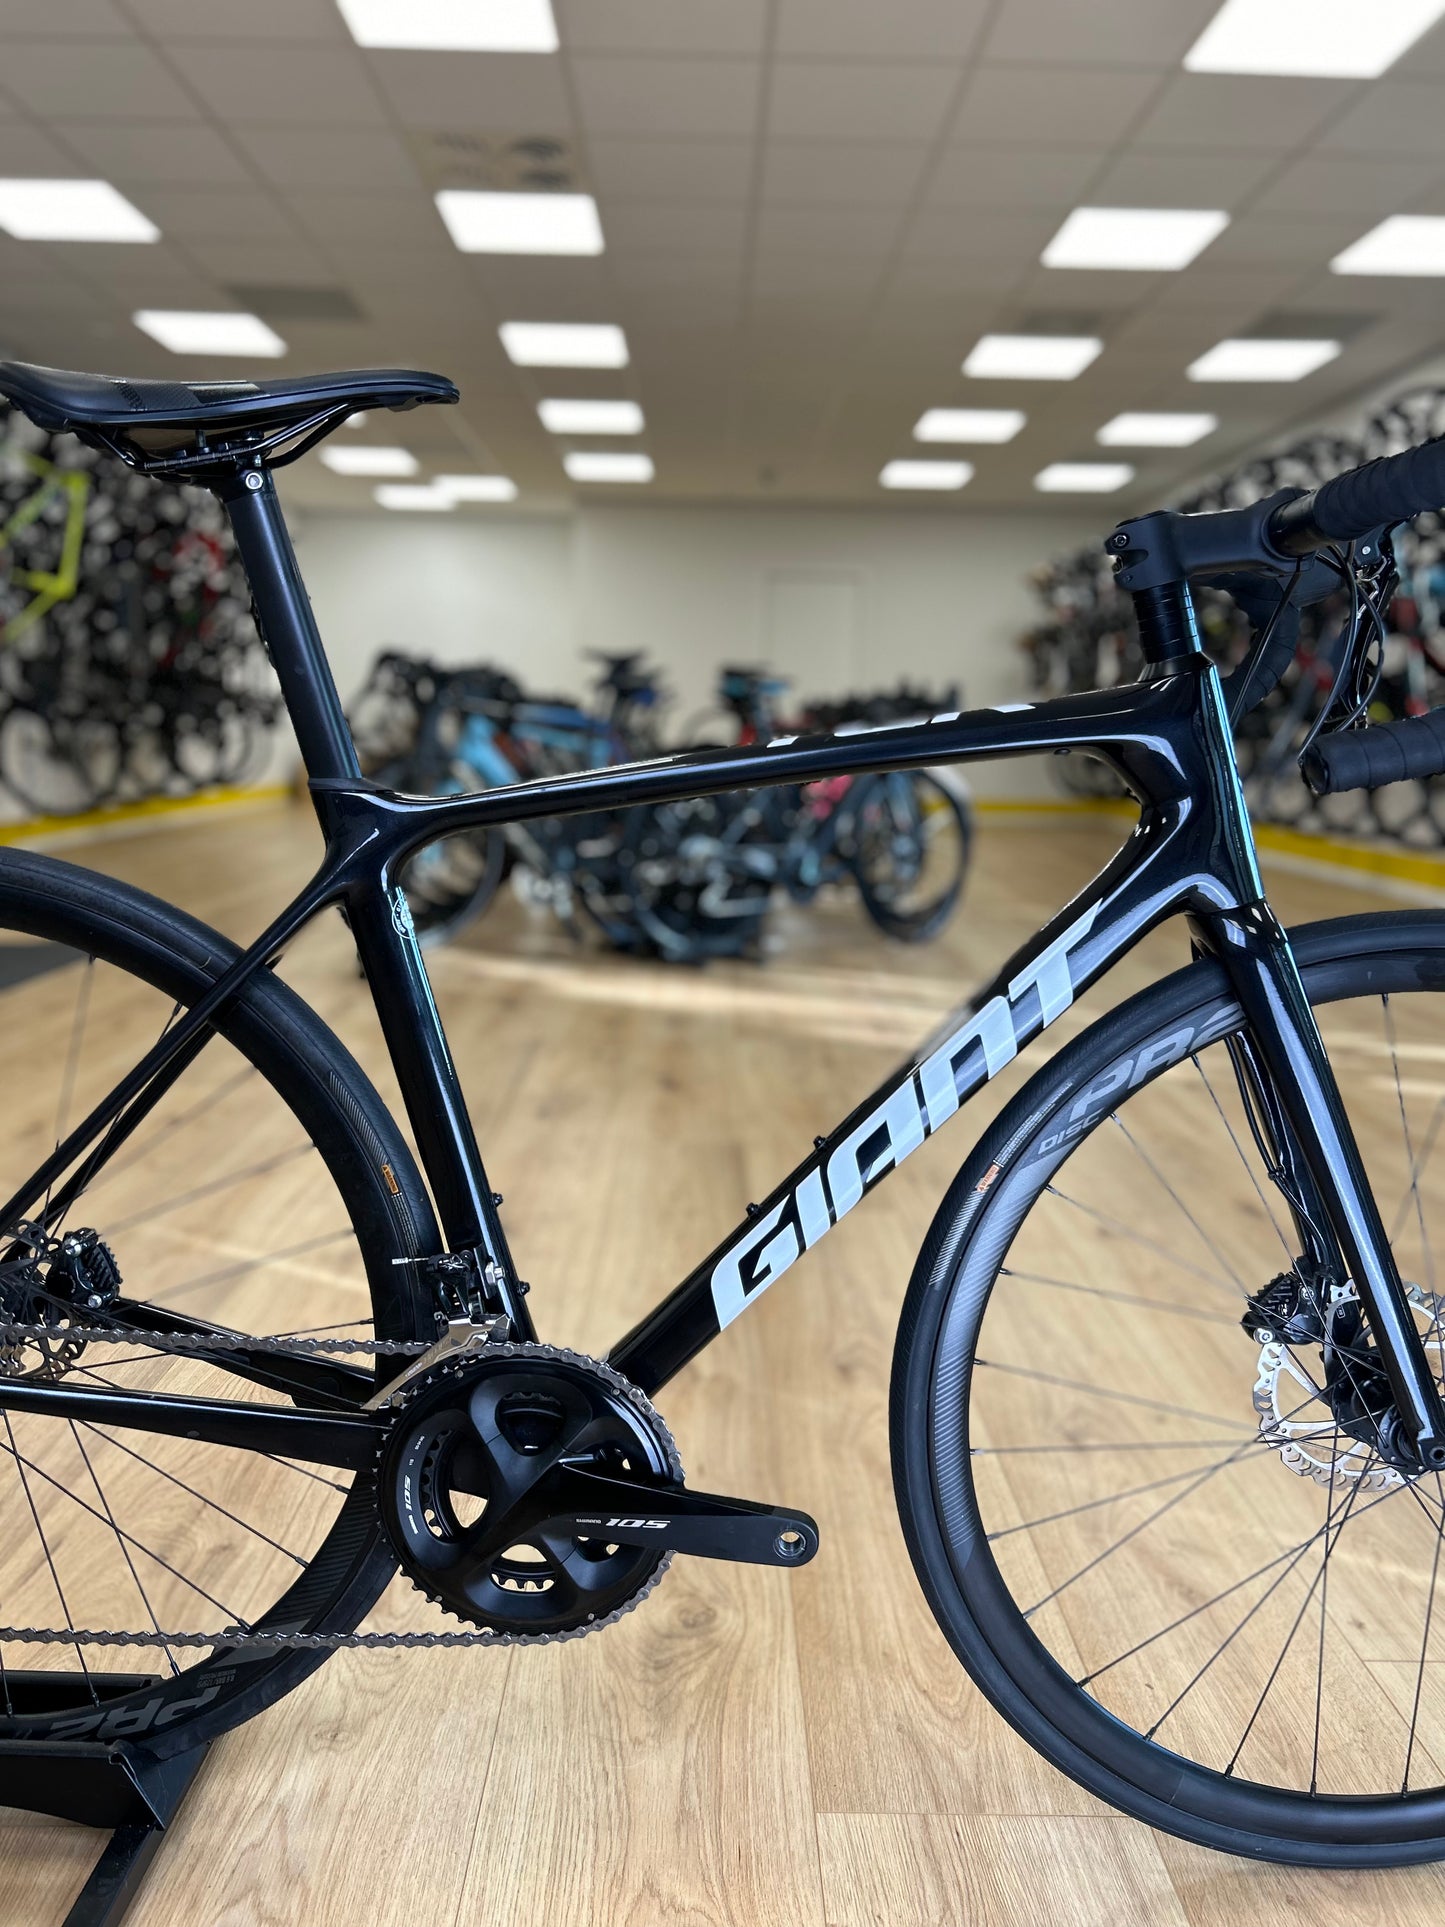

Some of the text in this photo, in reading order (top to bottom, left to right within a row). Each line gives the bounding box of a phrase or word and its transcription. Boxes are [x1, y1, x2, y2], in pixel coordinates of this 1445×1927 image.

[711, 898, 1103, 1332] GIANT
[1037, 1106, 1105, 1155] DISC
[404, 1474, 413, 1511] 105
[605, 1518, 671, 1529] 105
